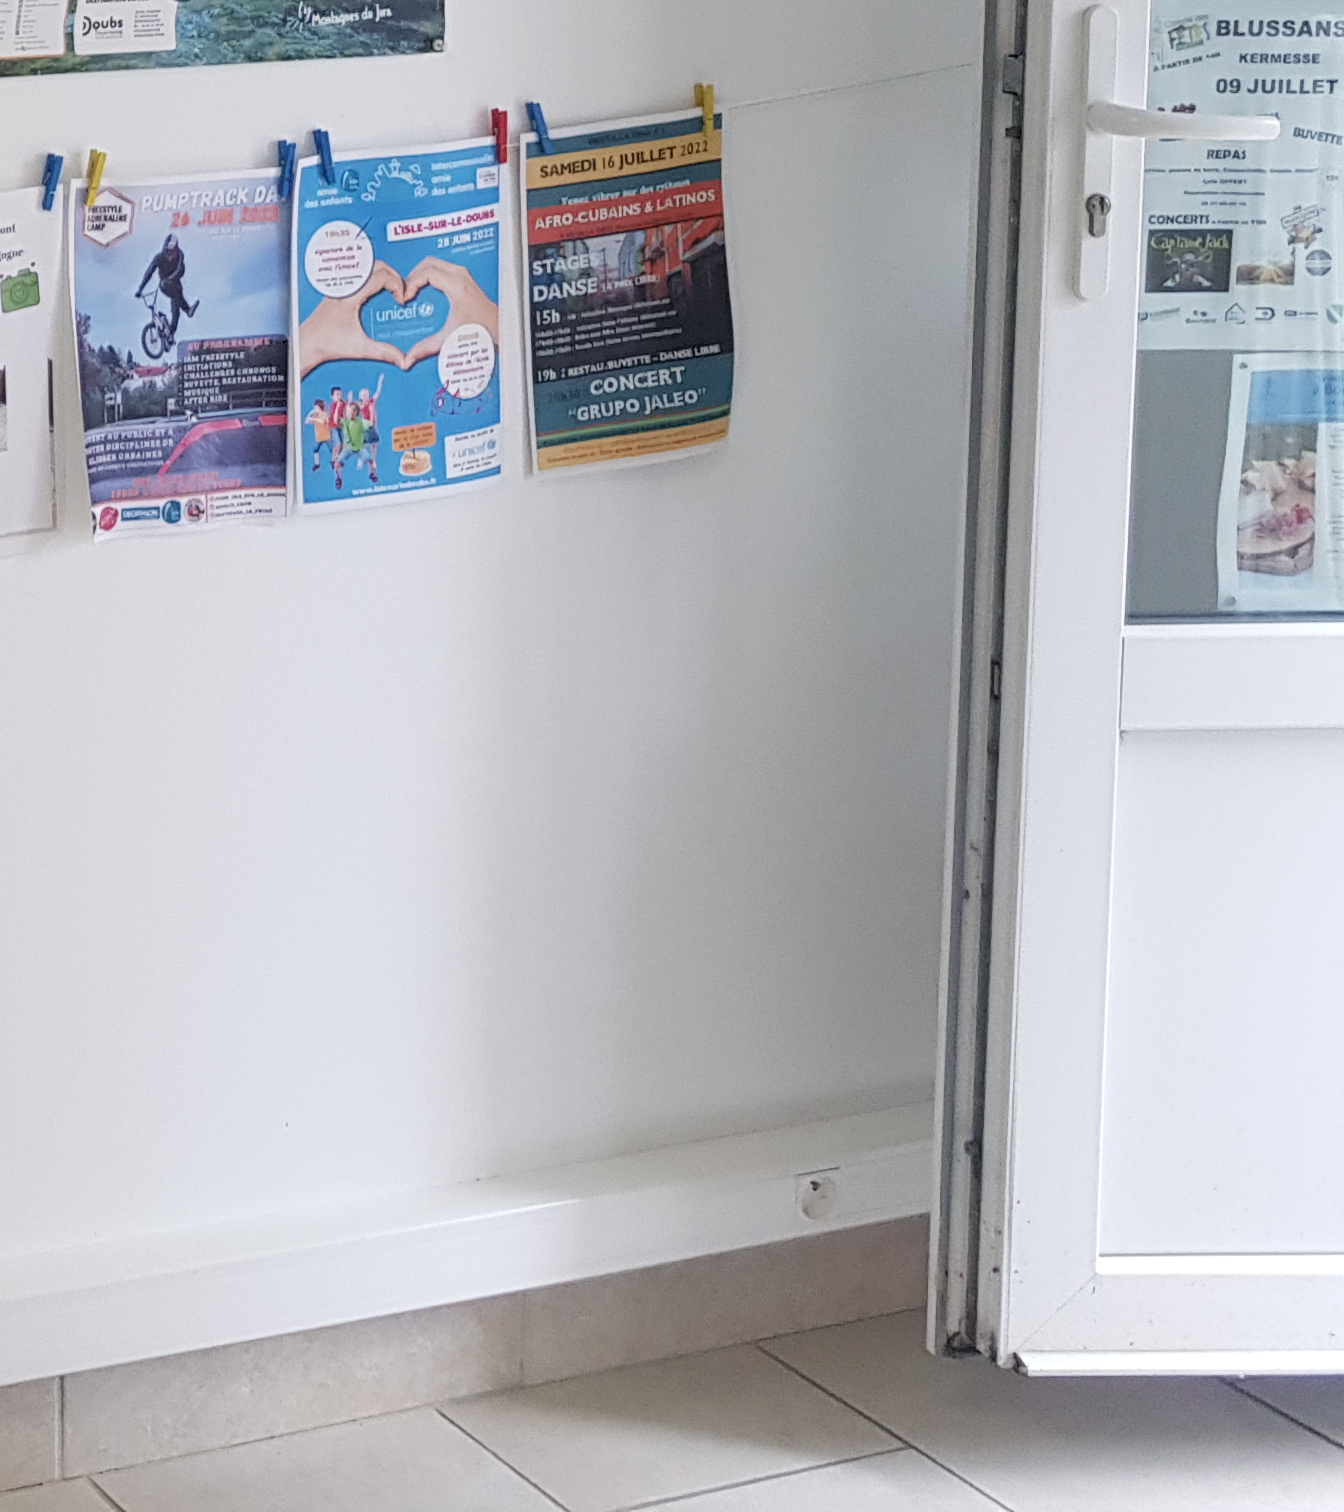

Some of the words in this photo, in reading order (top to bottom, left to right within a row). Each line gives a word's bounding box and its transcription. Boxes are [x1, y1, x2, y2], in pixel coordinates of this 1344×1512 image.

[1238, 51, 1321, 65] KERMESSE
[1216, 78, 1242, 94] 09
[1247, 78, 1339, 95] JUILLET
[540, 159, 596, 179] SAMEDI
[602, 155, 615, 170] 16
[619, 146, 676, 168] JUILLET
[680, 139, 708, 155] 2022
[534, 202, 640, 230] AFRO-CUBAINS
[644, 200, 653, 212] &
[655, 190, 716, 211] LATINOS
[533, 277, 597, 301] DANSE
[376, 303, 417, 322] unicef
[589, 367, 685, 396] CONCERT
